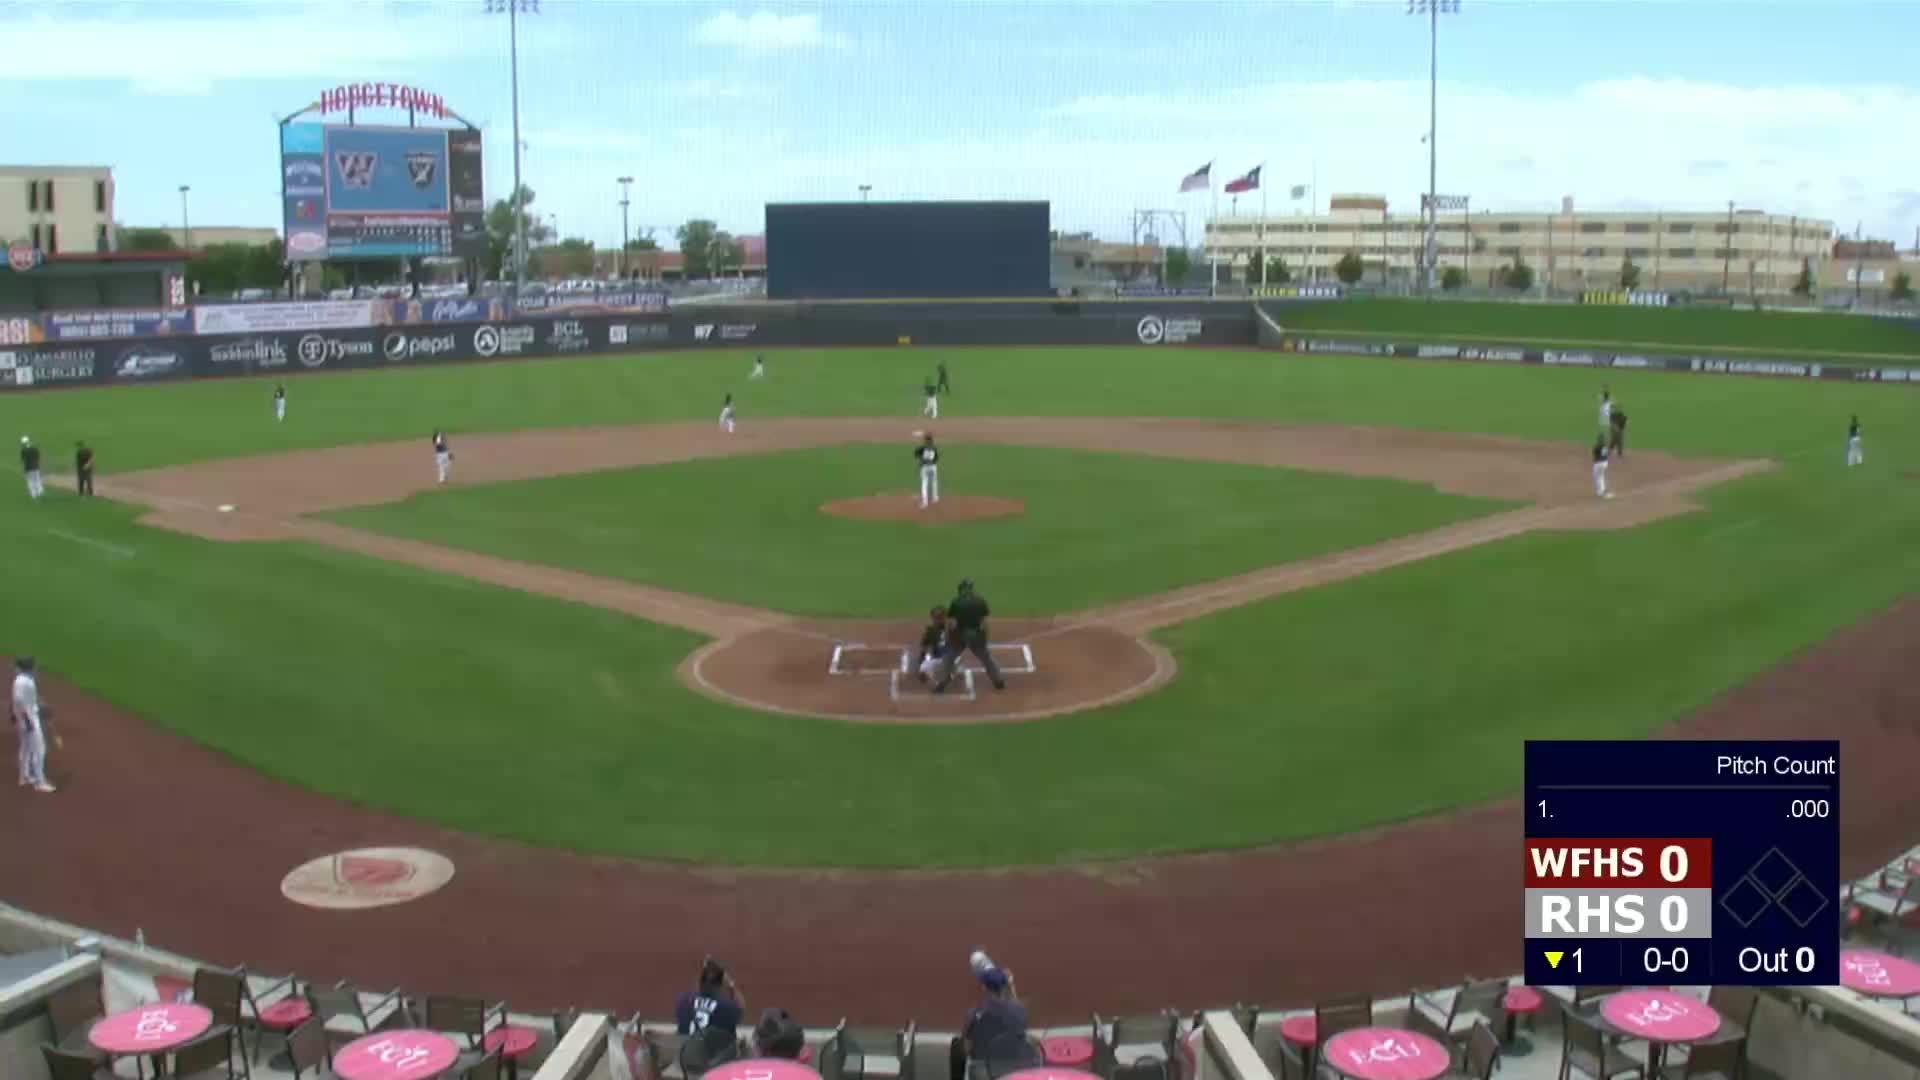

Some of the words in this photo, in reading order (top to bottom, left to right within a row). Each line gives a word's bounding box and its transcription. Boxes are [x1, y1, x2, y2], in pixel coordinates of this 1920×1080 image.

[320, 82, 444, 120] HODGETOWN
[328, 338, 373, 360] Tyson
[409, 334, 456, 358] pepsi
